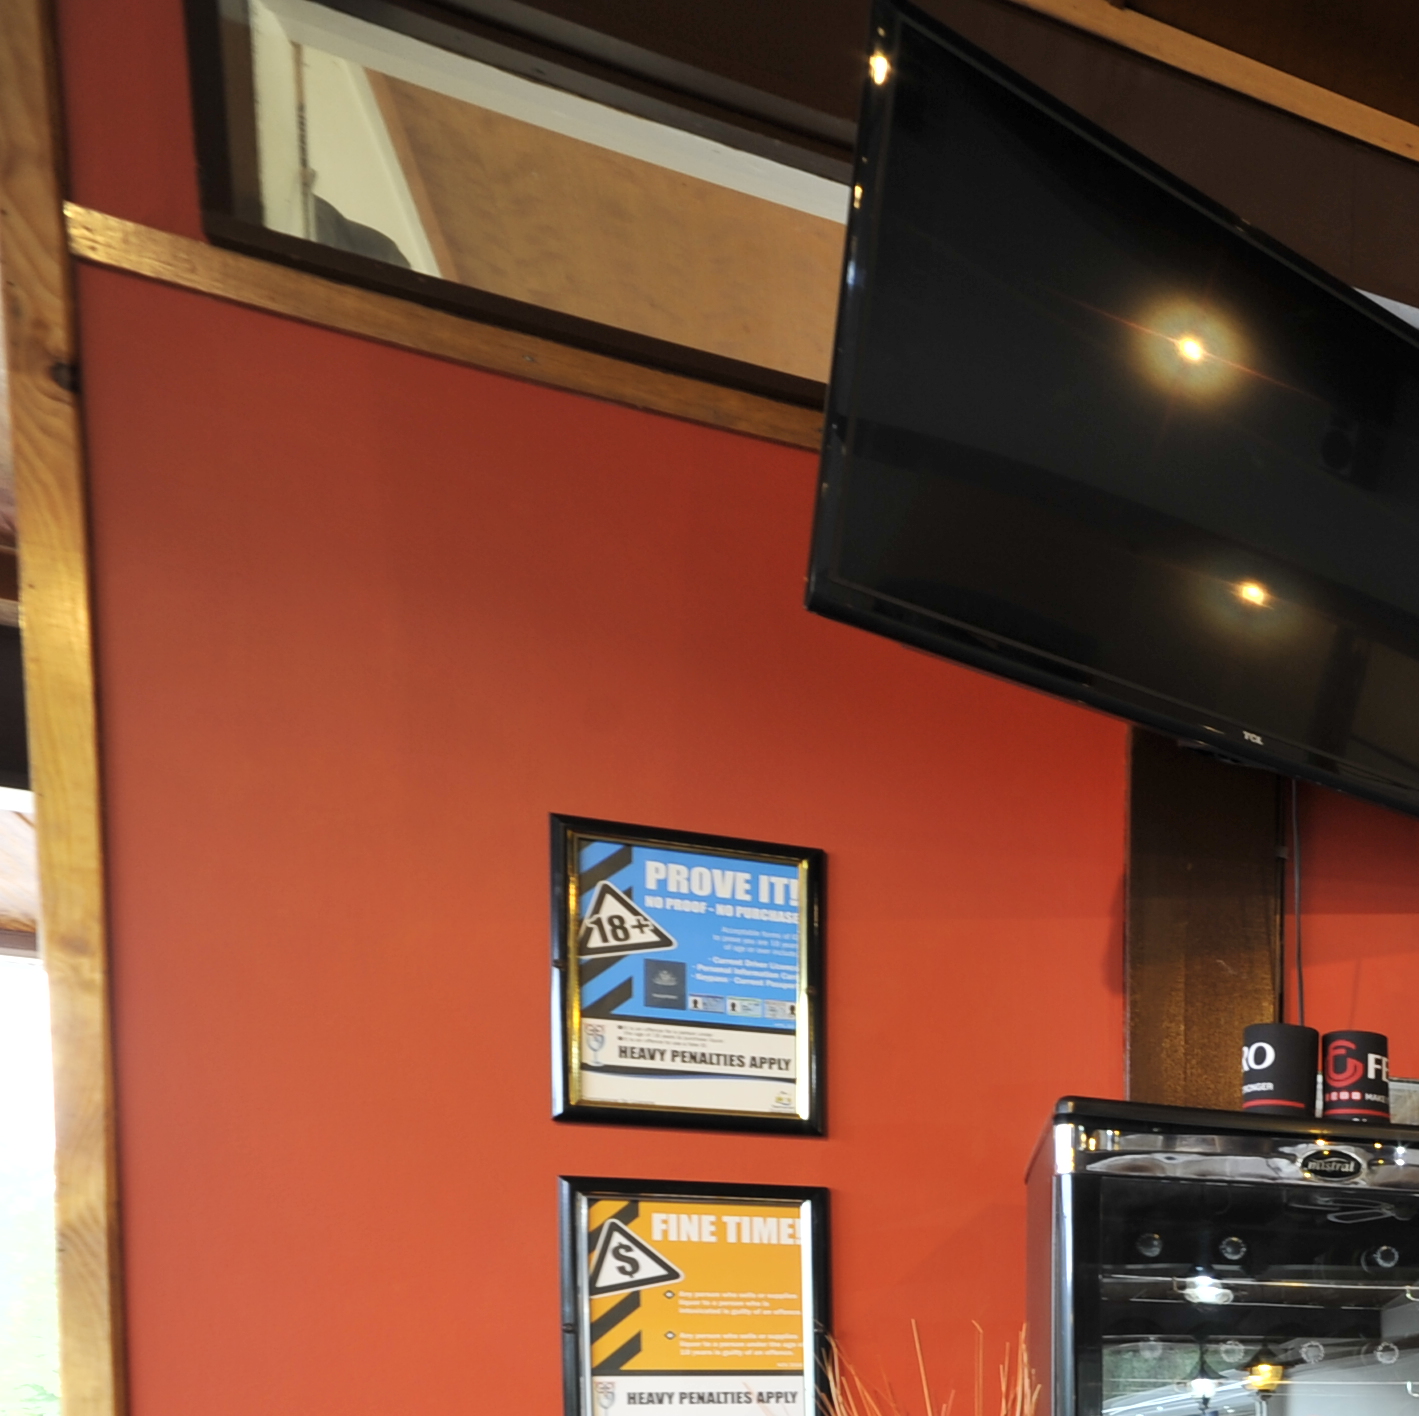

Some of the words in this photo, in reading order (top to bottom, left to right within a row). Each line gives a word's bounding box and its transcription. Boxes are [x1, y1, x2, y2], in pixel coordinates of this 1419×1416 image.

[644, 860, 752, 901] PROVE
[758, 874, 799, 907] IT!
[644, 895, 664, 909] NO
[665, 897, 708, 914] PROOF
[715, 903, 734, 917] NO
[588, 914, 650, 944] 18+
[618, 1045, 667, 1062] HEAVY
[671, 1050, 745, 1068] PENALTIES
[749, 1055, 792, 1072] APPLY
[1308, 1159, 1355, 1172] mistral
[651, 1213, 717, 1243] FINE
[722, 1215, 801, 1245] TIME!
[627, 1391, 674, 1405] HEAVY
[679, 1391, 752, 1405] PENALTIES
[756, 1391, 798, 1404] APPLY
